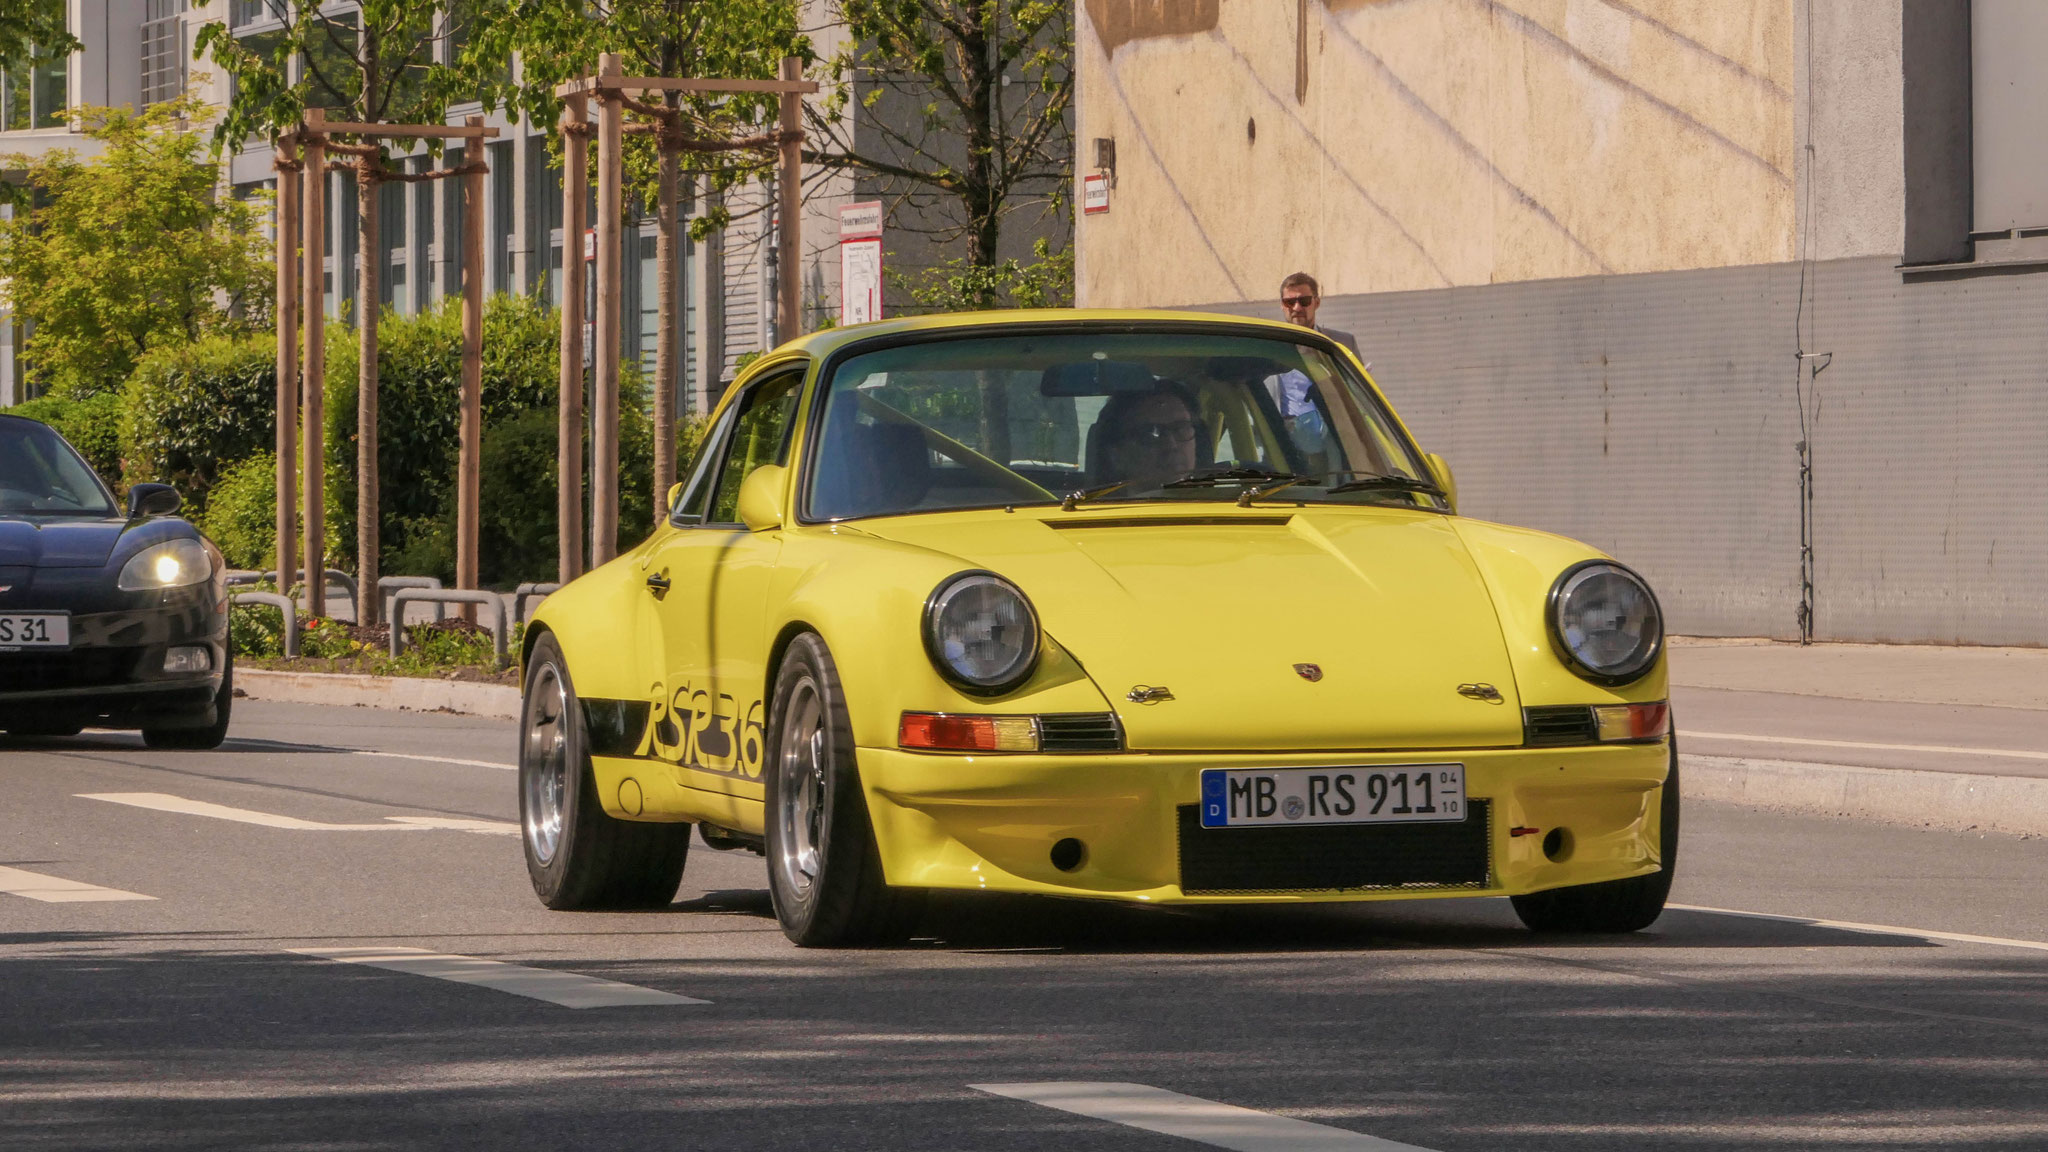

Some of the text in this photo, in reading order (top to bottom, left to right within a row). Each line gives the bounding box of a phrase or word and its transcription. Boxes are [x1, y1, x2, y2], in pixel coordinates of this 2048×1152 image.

[20, 618, 50, 642] 31
[1440, 771, 1457, 784] 04
[1230, 772, 1436, 818] MB RS 911
[1210, 804, 1220, 817] D
[1442, 801, 1458, 813] 10
